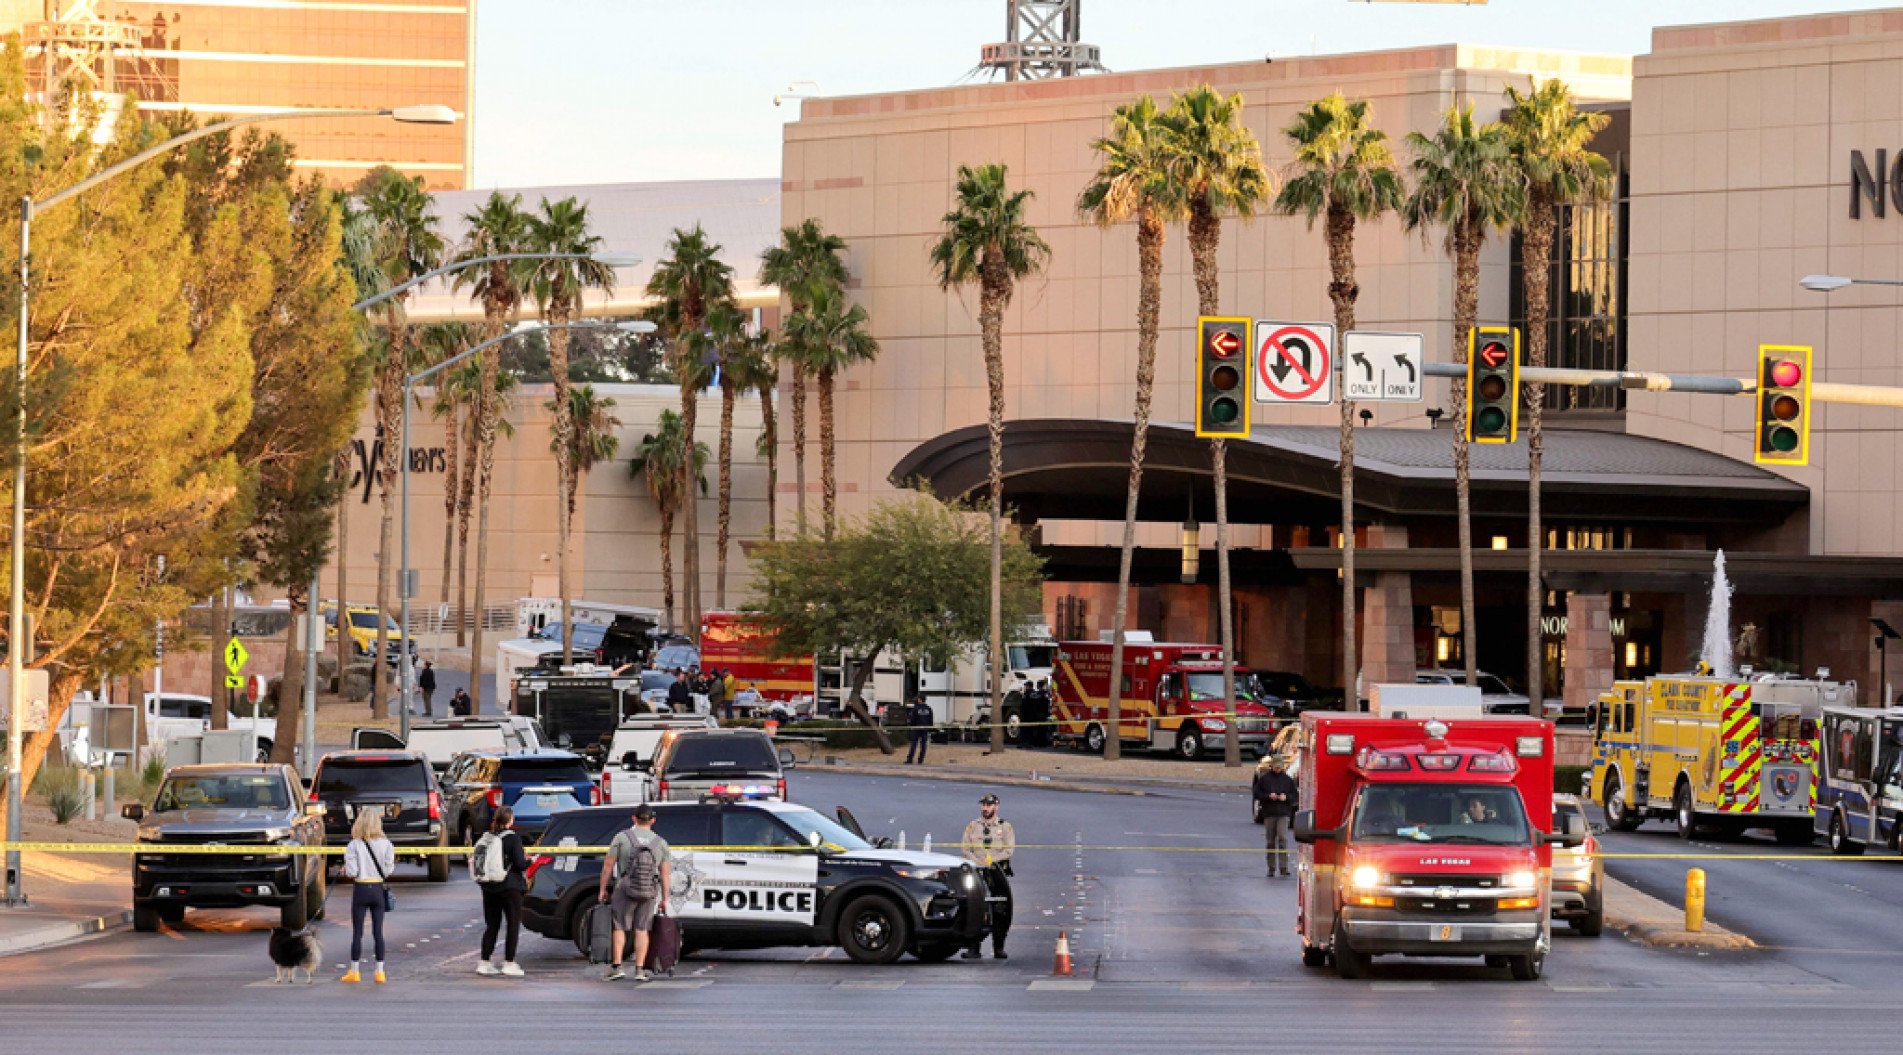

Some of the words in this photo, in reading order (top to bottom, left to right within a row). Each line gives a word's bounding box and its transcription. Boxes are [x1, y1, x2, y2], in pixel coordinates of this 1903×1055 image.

[1848, 148, 1903, 220] N
[1350, 383, 1377, 395] ONLY
[1388, 384, 1415, 395] ONLY
[1660, 682, 1680, 698] CLARK
[1683, 684, 1707, 700] COUNTY
[1420, 857, 1439, 866] LAS
[1441, 858, 1471, 866] VEGAS
[703, 889, 811, 912] POLICE
[1440, 925, 1452, 940] 8
